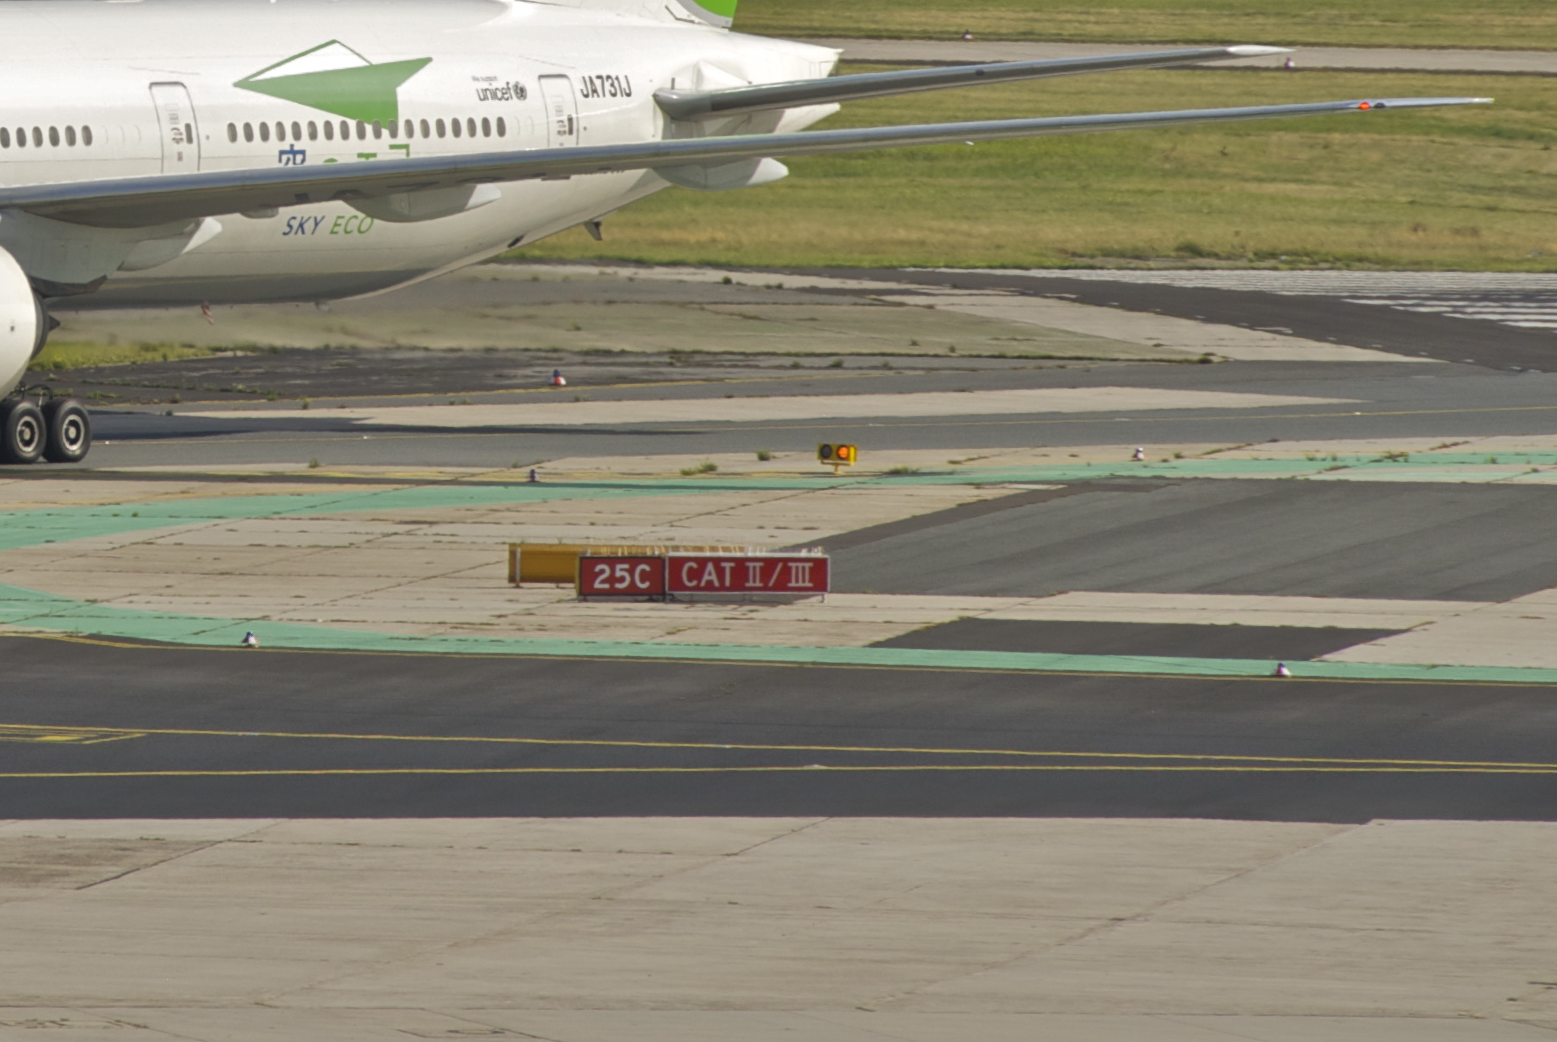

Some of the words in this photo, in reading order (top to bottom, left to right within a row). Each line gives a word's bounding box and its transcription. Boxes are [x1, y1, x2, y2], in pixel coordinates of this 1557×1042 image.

[476, 81, 513, 102] unicef
[580, 75, 632, 99] JA731J
[282, 215, 325, 236] SKY
[329, 214, 374, 235] ECO
[594, 564, 651, 589] 25C
[681, 561, 736, 587] CAT
